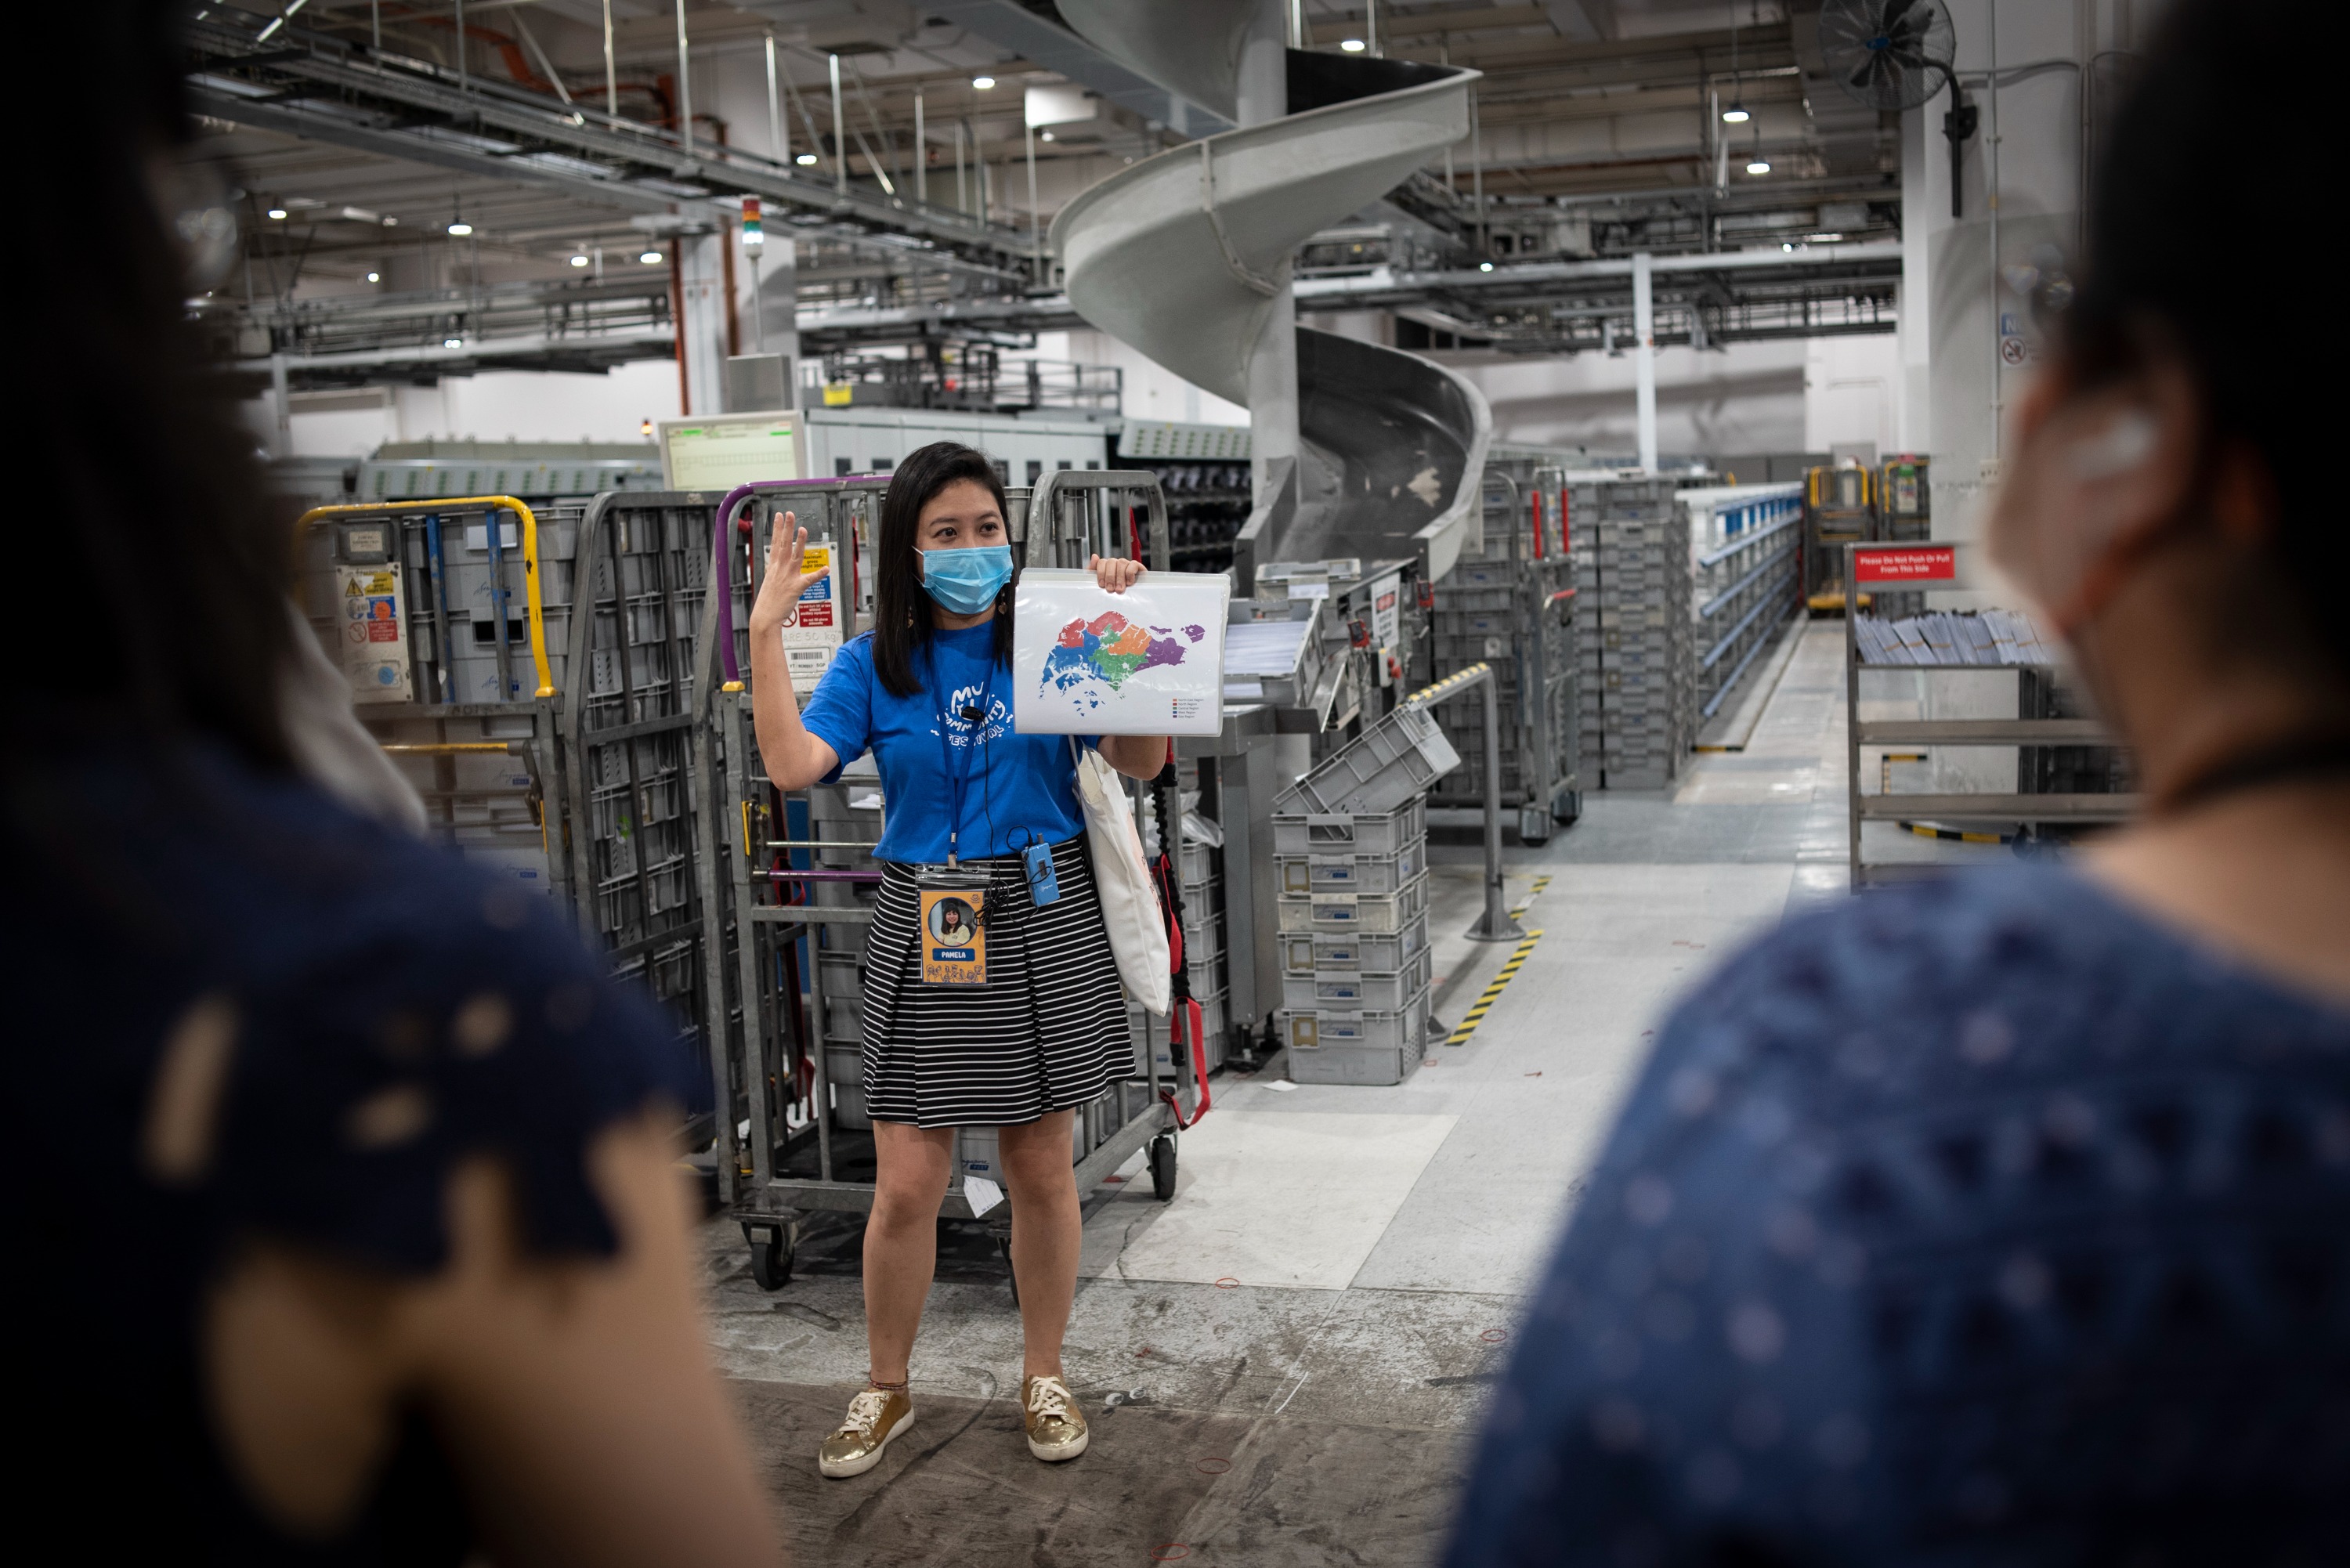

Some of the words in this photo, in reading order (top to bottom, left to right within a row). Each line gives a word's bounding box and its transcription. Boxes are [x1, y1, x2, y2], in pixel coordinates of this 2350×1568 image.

[1908, 555, 1925, 563] Push
[1936, 554, 1950, 562] Pull
[783, 633, 801, 641] ARE
